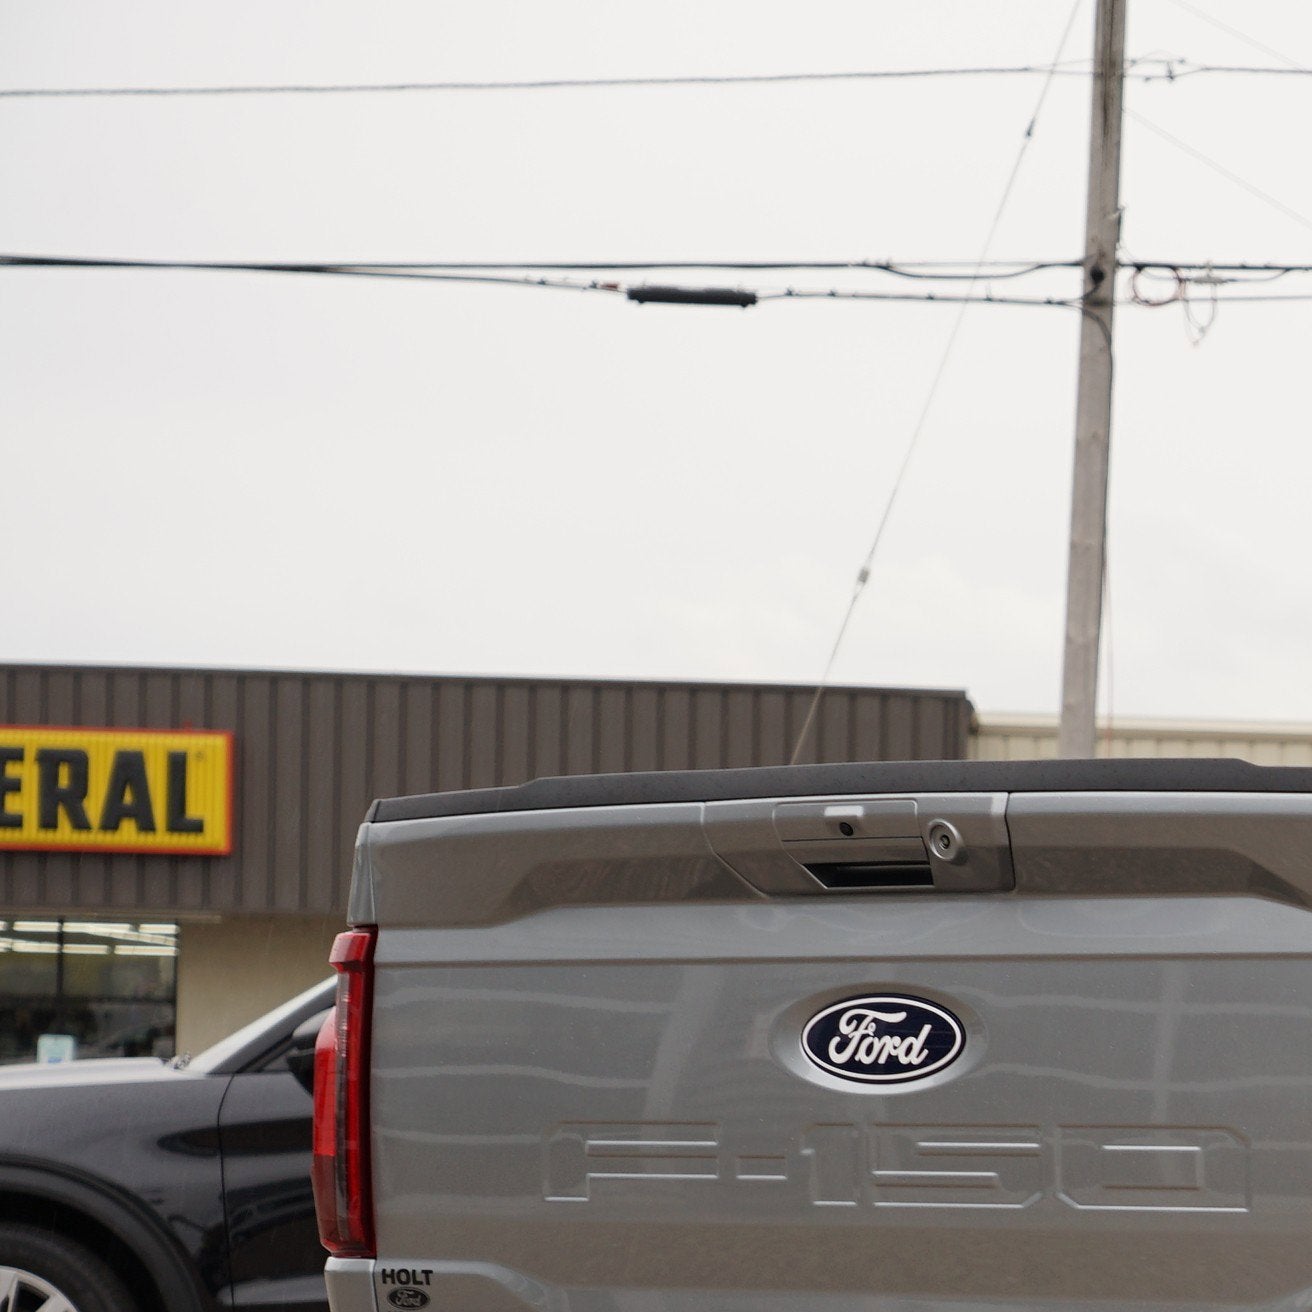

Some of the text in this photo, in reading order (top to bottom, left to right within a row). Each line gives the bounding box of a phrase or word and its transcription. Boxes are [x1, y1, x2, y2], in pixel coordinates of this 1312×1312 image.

[828, 1008, 932, 1064] Ford
[542, 1120, 1249, 1212] F-150
[381, 1268, 433, 1286] HOLT
